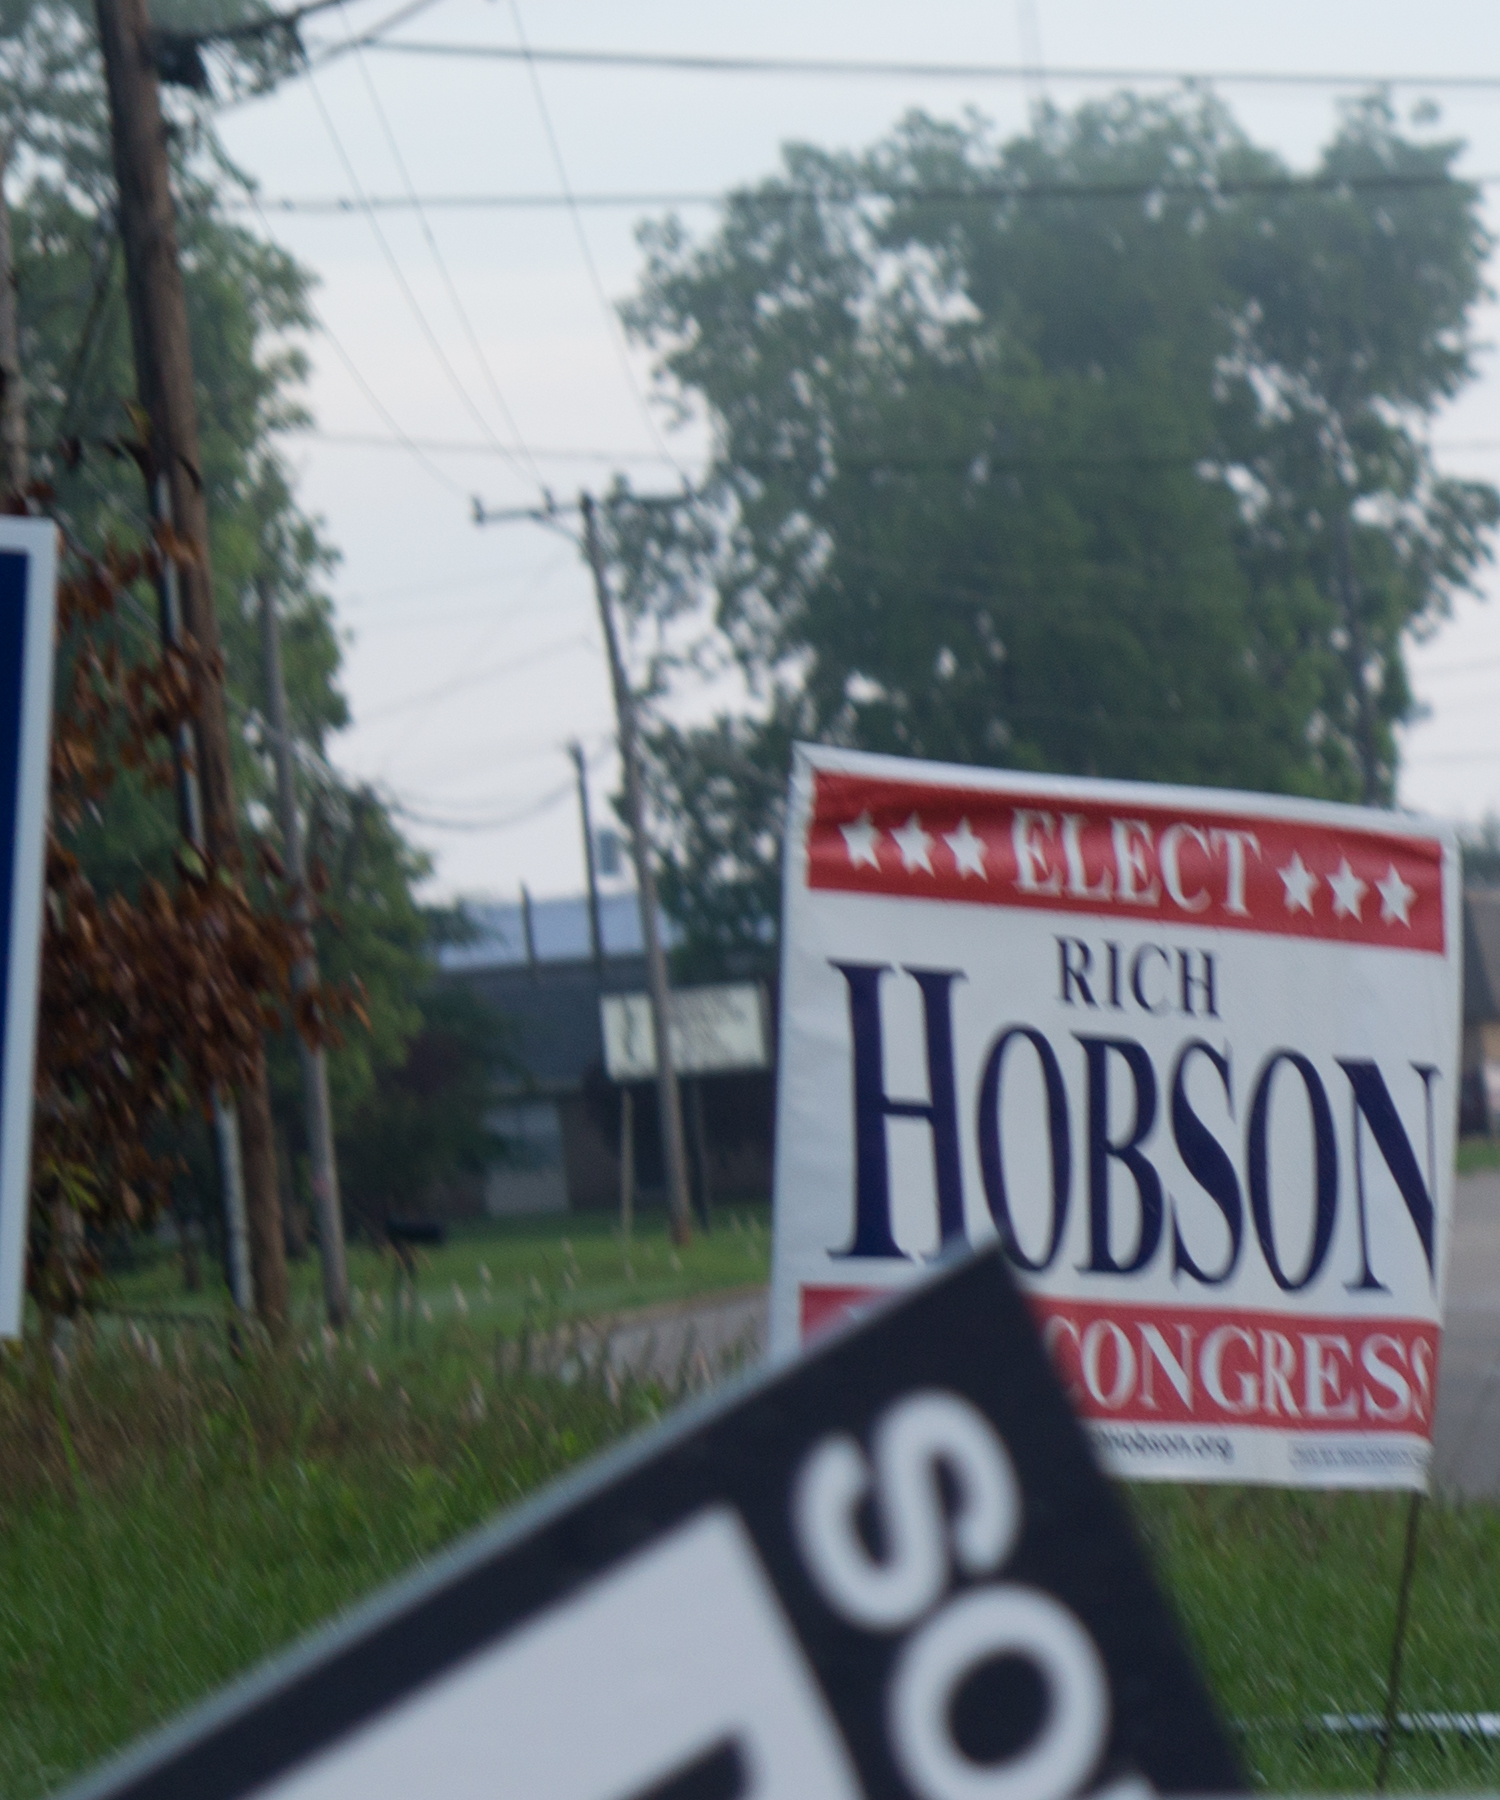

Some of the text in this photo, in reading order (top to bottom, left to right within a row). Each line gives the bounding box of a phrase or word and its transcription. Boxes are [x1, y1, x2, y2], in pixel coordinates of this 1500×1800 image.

[1010, 806, 1263, 915] ELECT
[1054, 933, 1221, 1018] RICH
[825, 956, 1443, 1296] HOBSON
